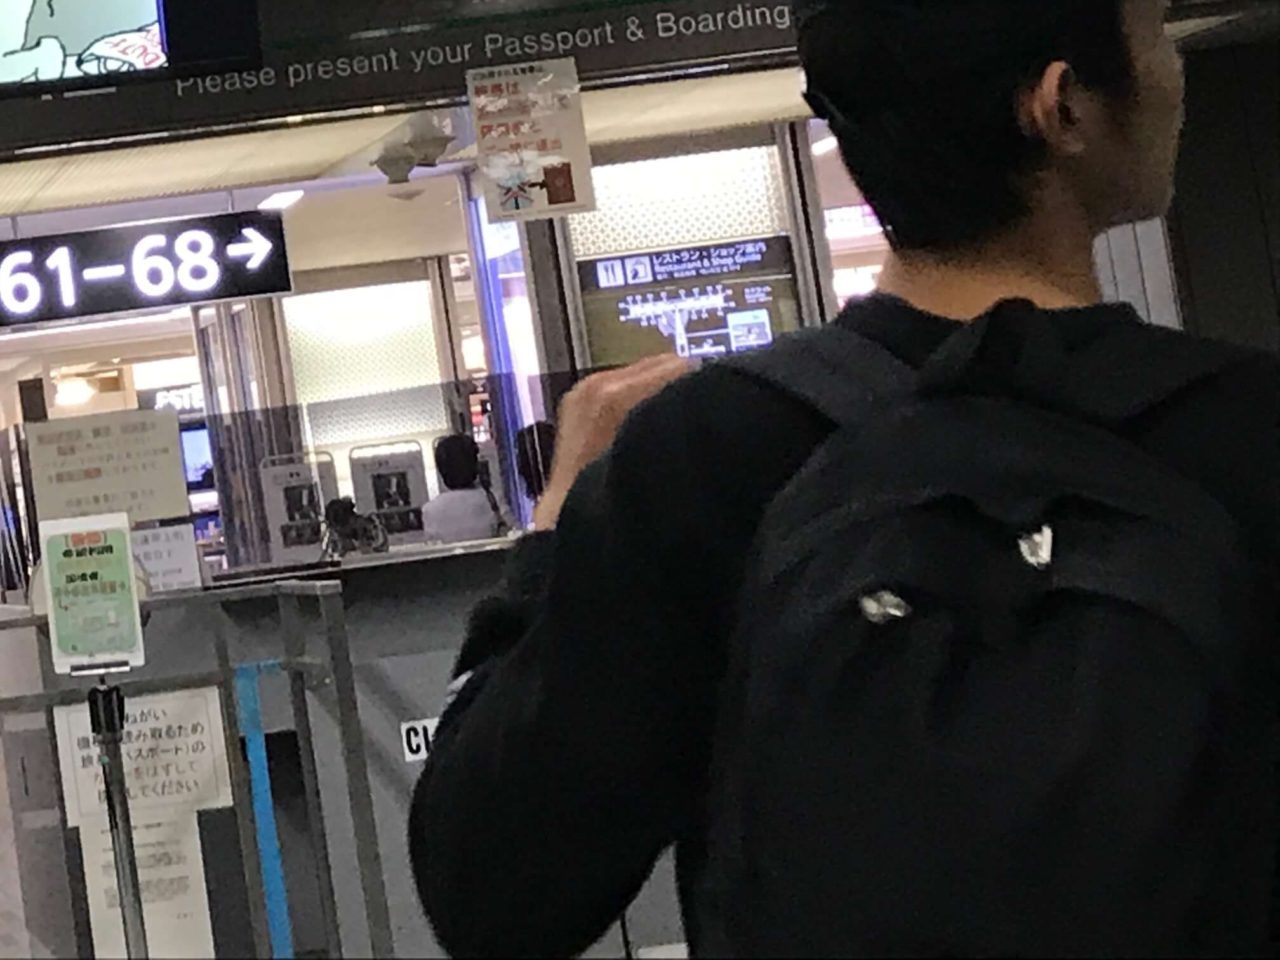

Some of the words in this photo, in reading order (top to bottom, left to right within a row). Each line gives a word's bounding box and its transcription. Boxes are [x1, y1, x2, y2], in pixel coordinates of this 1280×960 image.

[287, 47, 399, 87] present
[410, 43, 472, 72] your
[484, 21, 615, 58] Passport
[626, 17, 645, 41] &
[656, 5, 790, 38] Boarding
